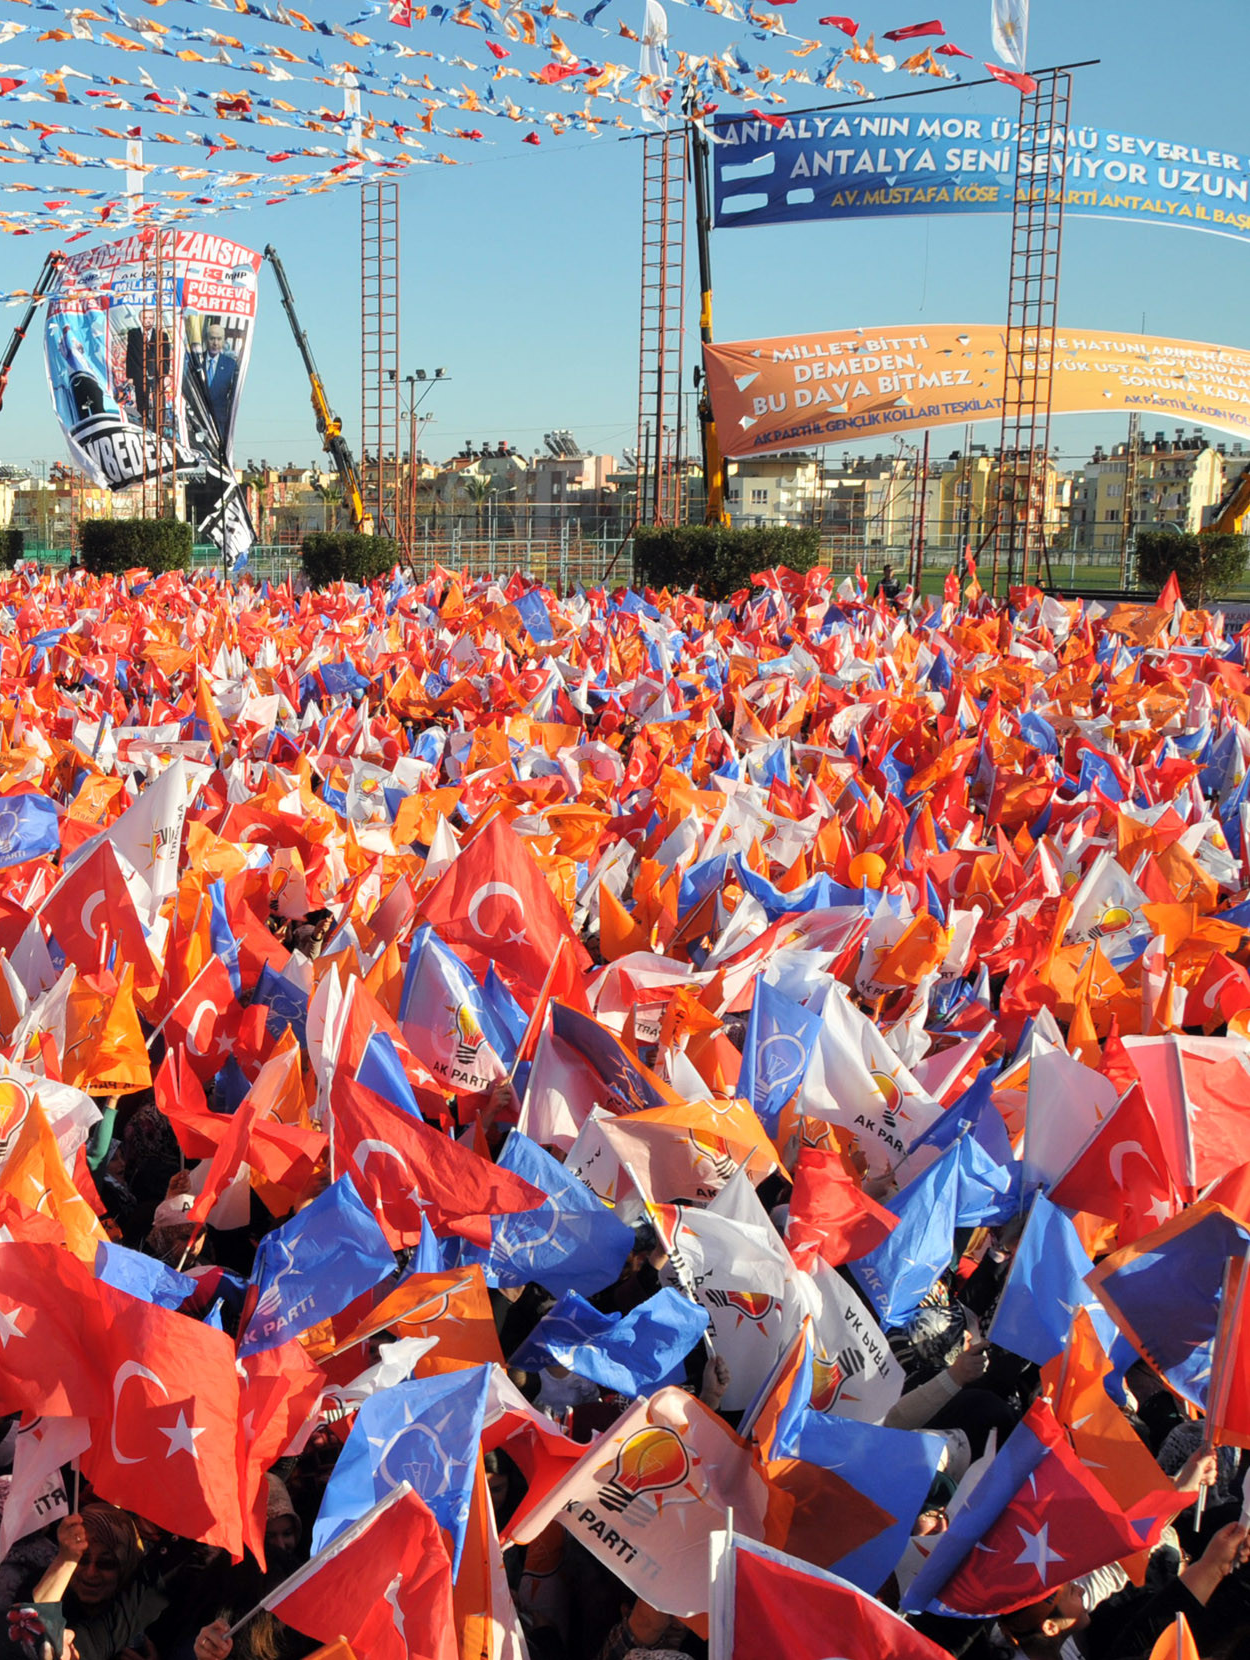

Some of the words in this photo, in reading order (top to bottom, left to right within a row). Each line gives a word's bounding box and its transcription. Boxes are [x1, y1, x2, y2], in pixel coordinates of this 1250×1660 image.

[723, 117, 908, 147] ANTALYA'NIN
[916, 118, 981, 139] MOR
[991, 116, 1098, 149] ÜZÜMÜ
[1106, 134, 1242, 171] SEVERLER
[790, 148, 936, 178] ANTALYA
[945, 146, 1010, 173] SENİ
[1018, 151, 1148, 184] SEVİYOR
[1158, 167, 1248, 203] UZUN
[954, 183, 999, 202] KÖSE
[1016, 188, 1040, 202] AK
[1100, 194, 1193, 218] ANTALYA
[225, 271, 247, 281] MHP
[772, 341, 858, 363] MİLLET
[865, 334, 929, 352] BİTTİ
[794, 354, 923, 383] DEMEDEN,
[1024, 358, 1091, 372] BÜYÜK
[753, 395, 786, 416] BU
[794, 380, 871, 408] DAVA
[878, 369, 973, 393] BİTMEZ
[1119, 375, 1201, 394] SONUNA
[754, 433, 773, 447] AK
[826, 410, 880, 434] GENÇLİK
[883, 404, 940, 423] KOLLARI
[433, 1061, 448, 1076] AK
[854, 1114, 876, 1132] AK
[878, 1128, 907, 1156] PAR
[696, 1187, 717, 1198] AK
[862, 1267, 882, 1290] AK
